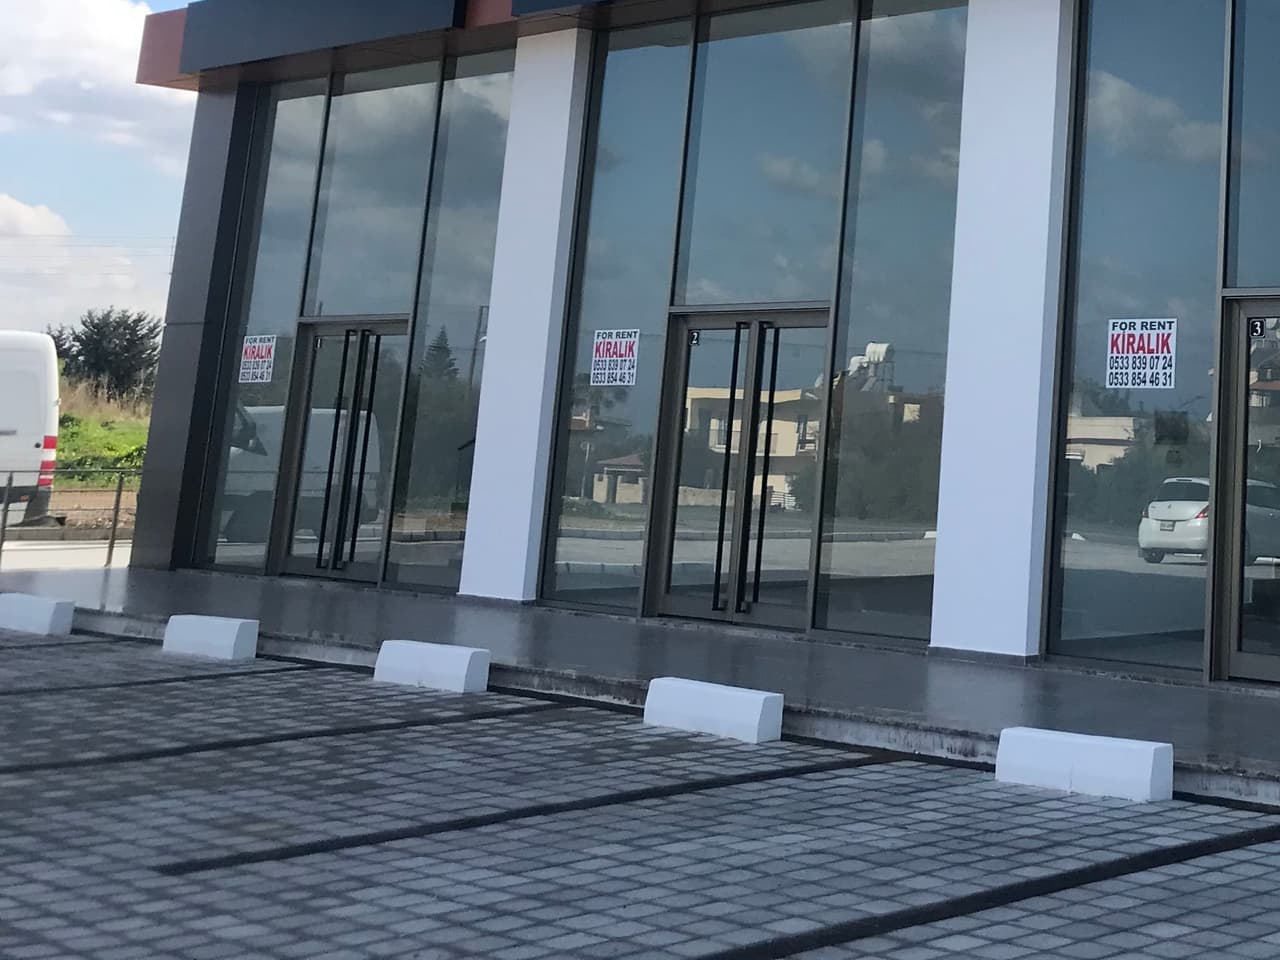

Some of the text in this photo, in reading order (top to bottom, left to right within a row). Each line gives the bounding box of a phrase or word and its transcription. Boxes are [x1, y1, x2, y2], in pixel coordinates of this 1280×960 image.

[1111, 320, 1175, 331] FOR RENT
[1253, 321, 1261, 336] 3
[615, 331, 638, 339] RENT
[692, 332, 698, 344] 2
[1109, 355, 1173, 370] 0533 839 07 24
[1108, 372, 1172, 386] 0533 854 46 31
